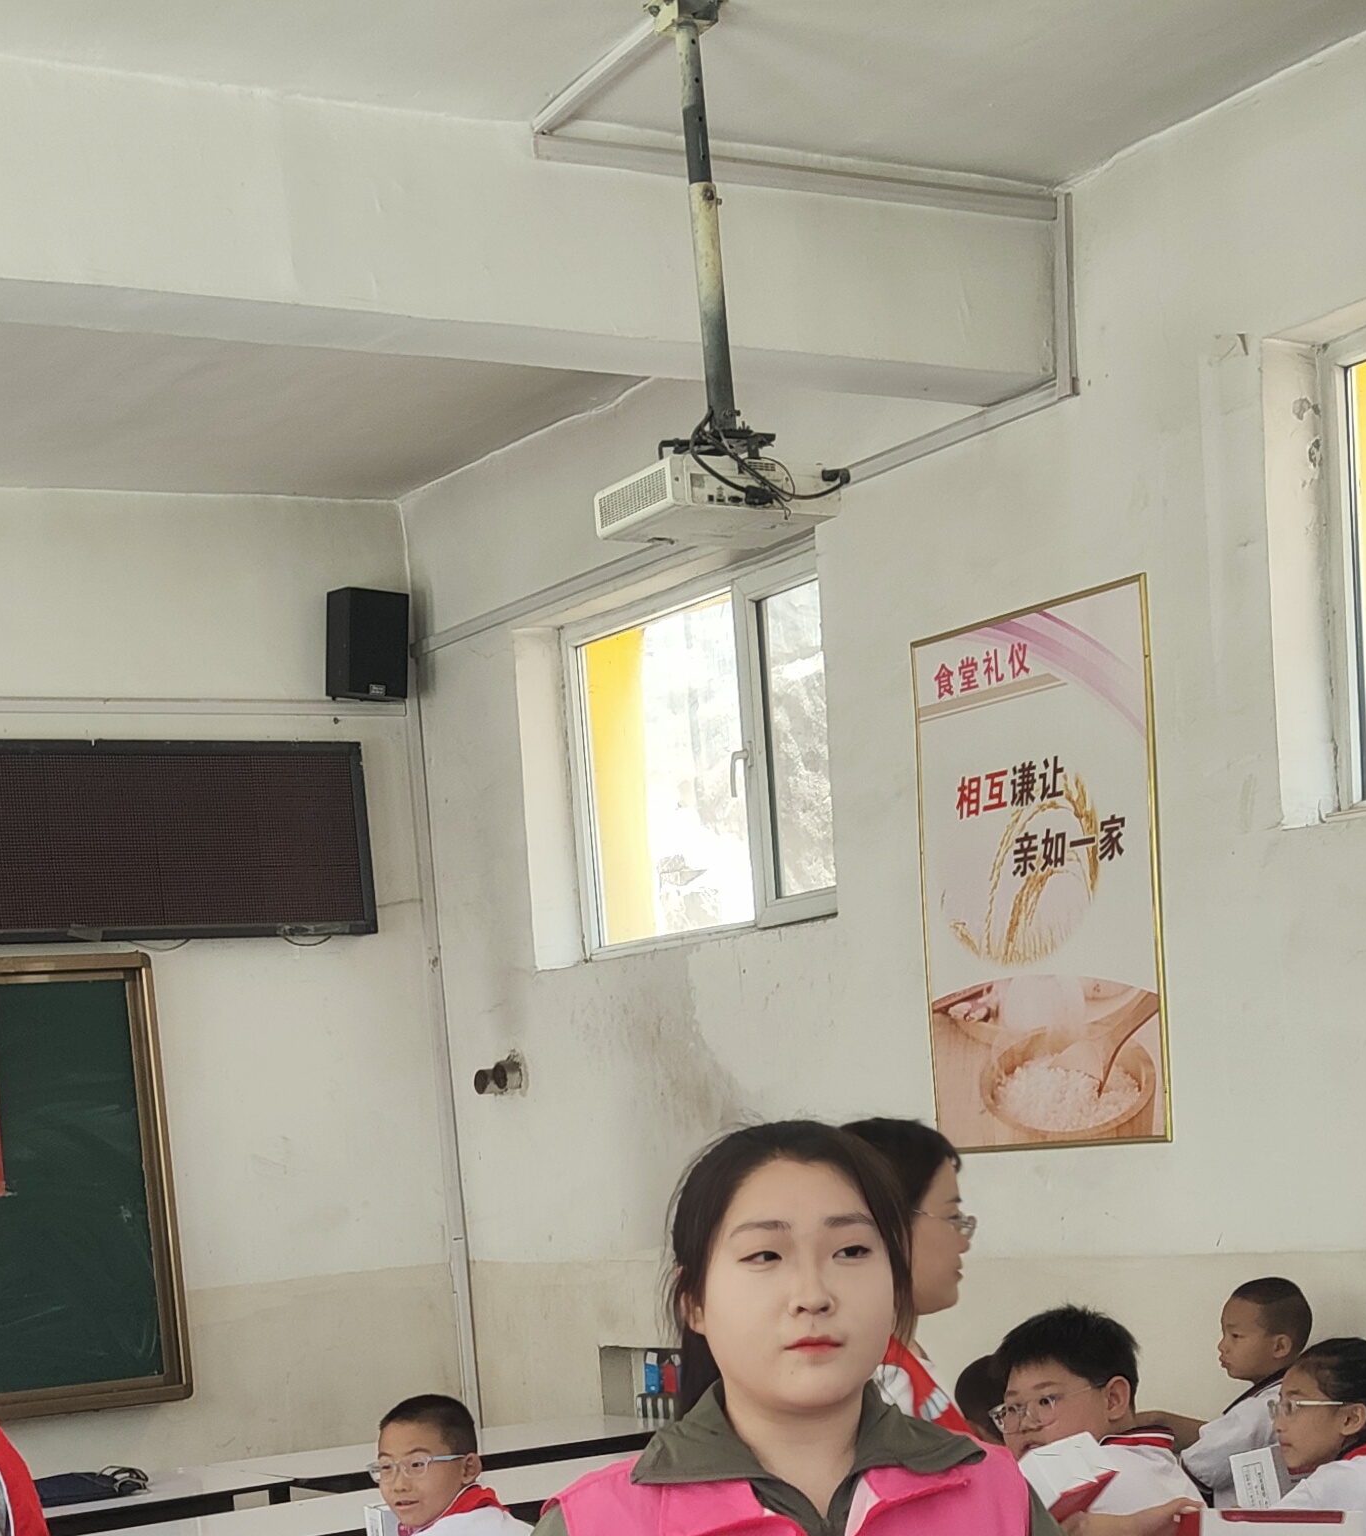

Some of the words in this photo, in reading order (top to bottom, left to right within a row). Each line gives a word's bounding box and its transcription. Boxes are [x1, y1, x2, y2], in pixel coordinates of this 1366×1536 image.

[934, 641, 1031, 700] 食堂礼仪
[955, 755, 1065, 820] 相互谦让
[1012, 814, 1126, 878] 亲如一家
